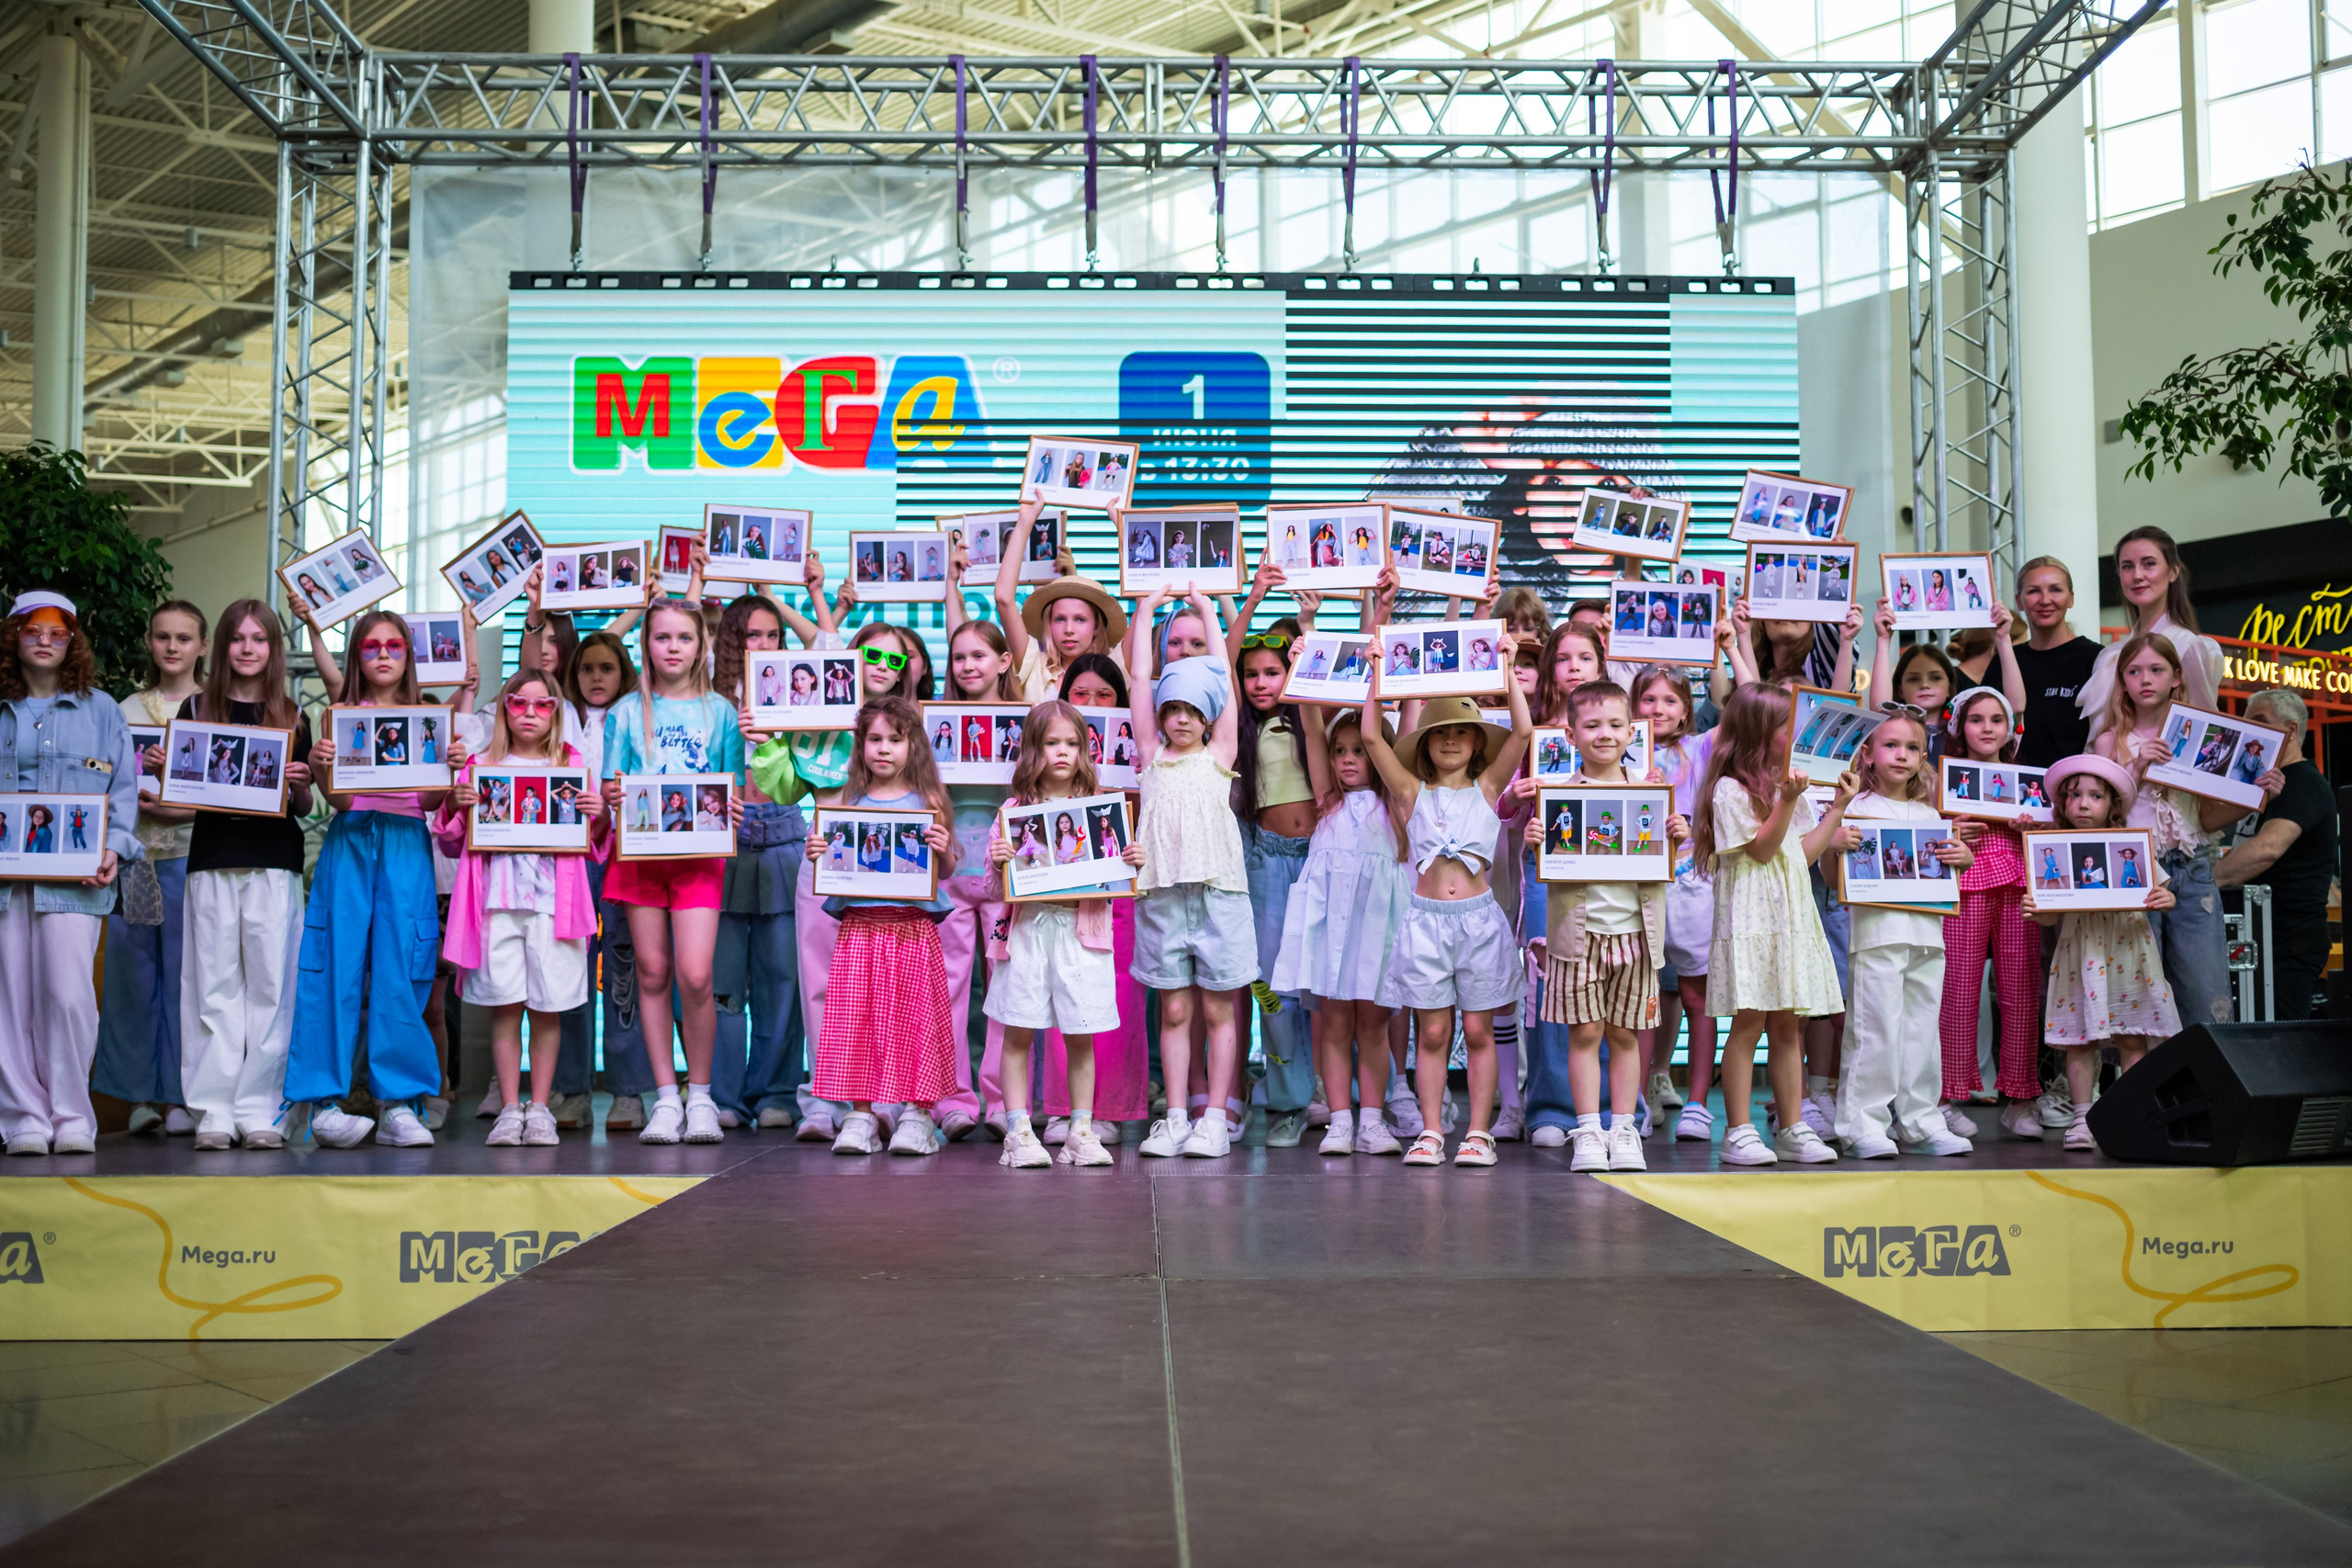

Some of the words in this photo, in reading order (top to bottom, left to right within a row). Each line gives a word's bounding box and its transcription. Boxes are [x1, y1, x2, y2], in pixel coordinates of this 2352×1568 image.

[1181, 374, 1204, 420] 1
[2236, 658, 2279, 683] LOVE
[2283, 665, 2322, 690] MAKE
[2325, 671, 2352, 694] CO
[181, 1246, 276, 1269] Mega.ru
[2142, 1236, 2234, 1259] Mega.ru
